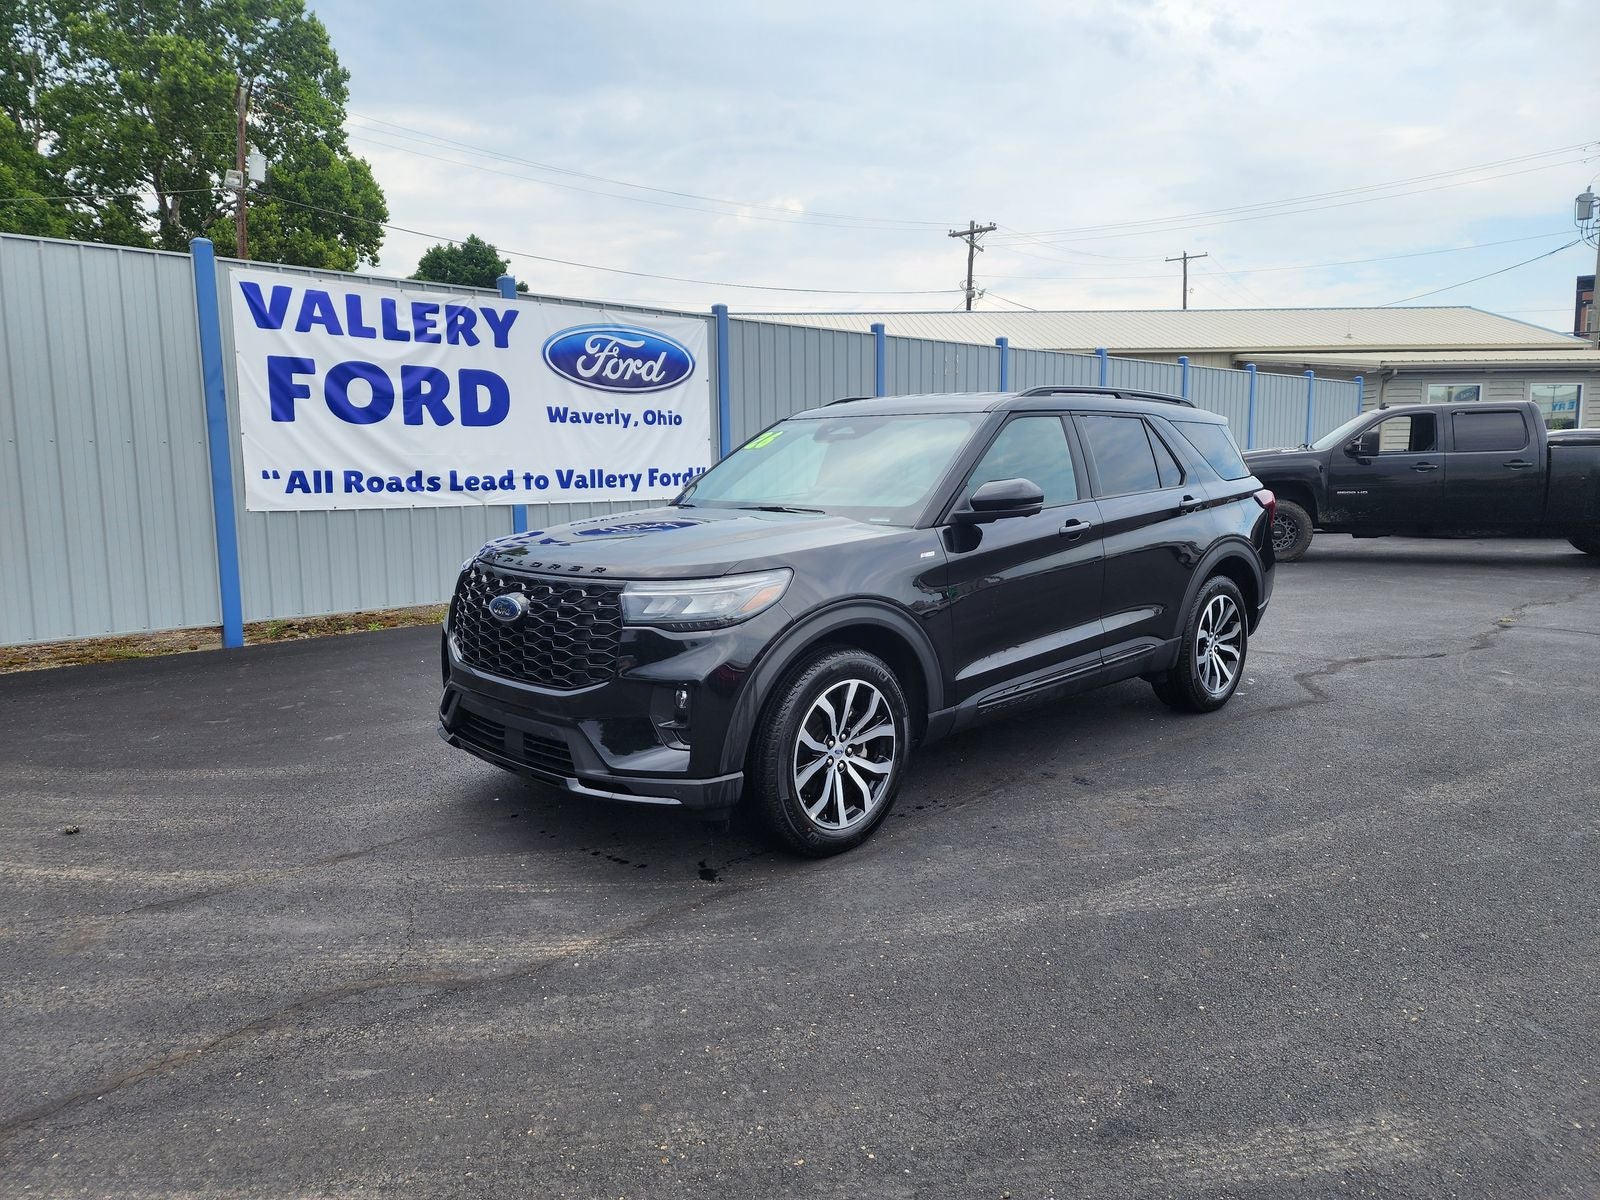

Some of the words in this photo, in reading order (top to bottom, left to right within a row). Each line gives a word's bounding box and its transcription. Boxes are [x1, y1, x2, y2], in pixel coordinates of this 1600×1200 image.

[239, 280, 519, 348] VALLERY
[576, 334, 668, 383] Ford
[267, 355, 510, 427] FORD
[546, 406, 639, 428] Waverly,
[643, 409, 683, 426] Ohio
[343, 470, 442, 493] Roads
[449, 469, 517, 492] Lead
[523, 472, 550, 491] to
[555, 469, 642, 492] Vallery
